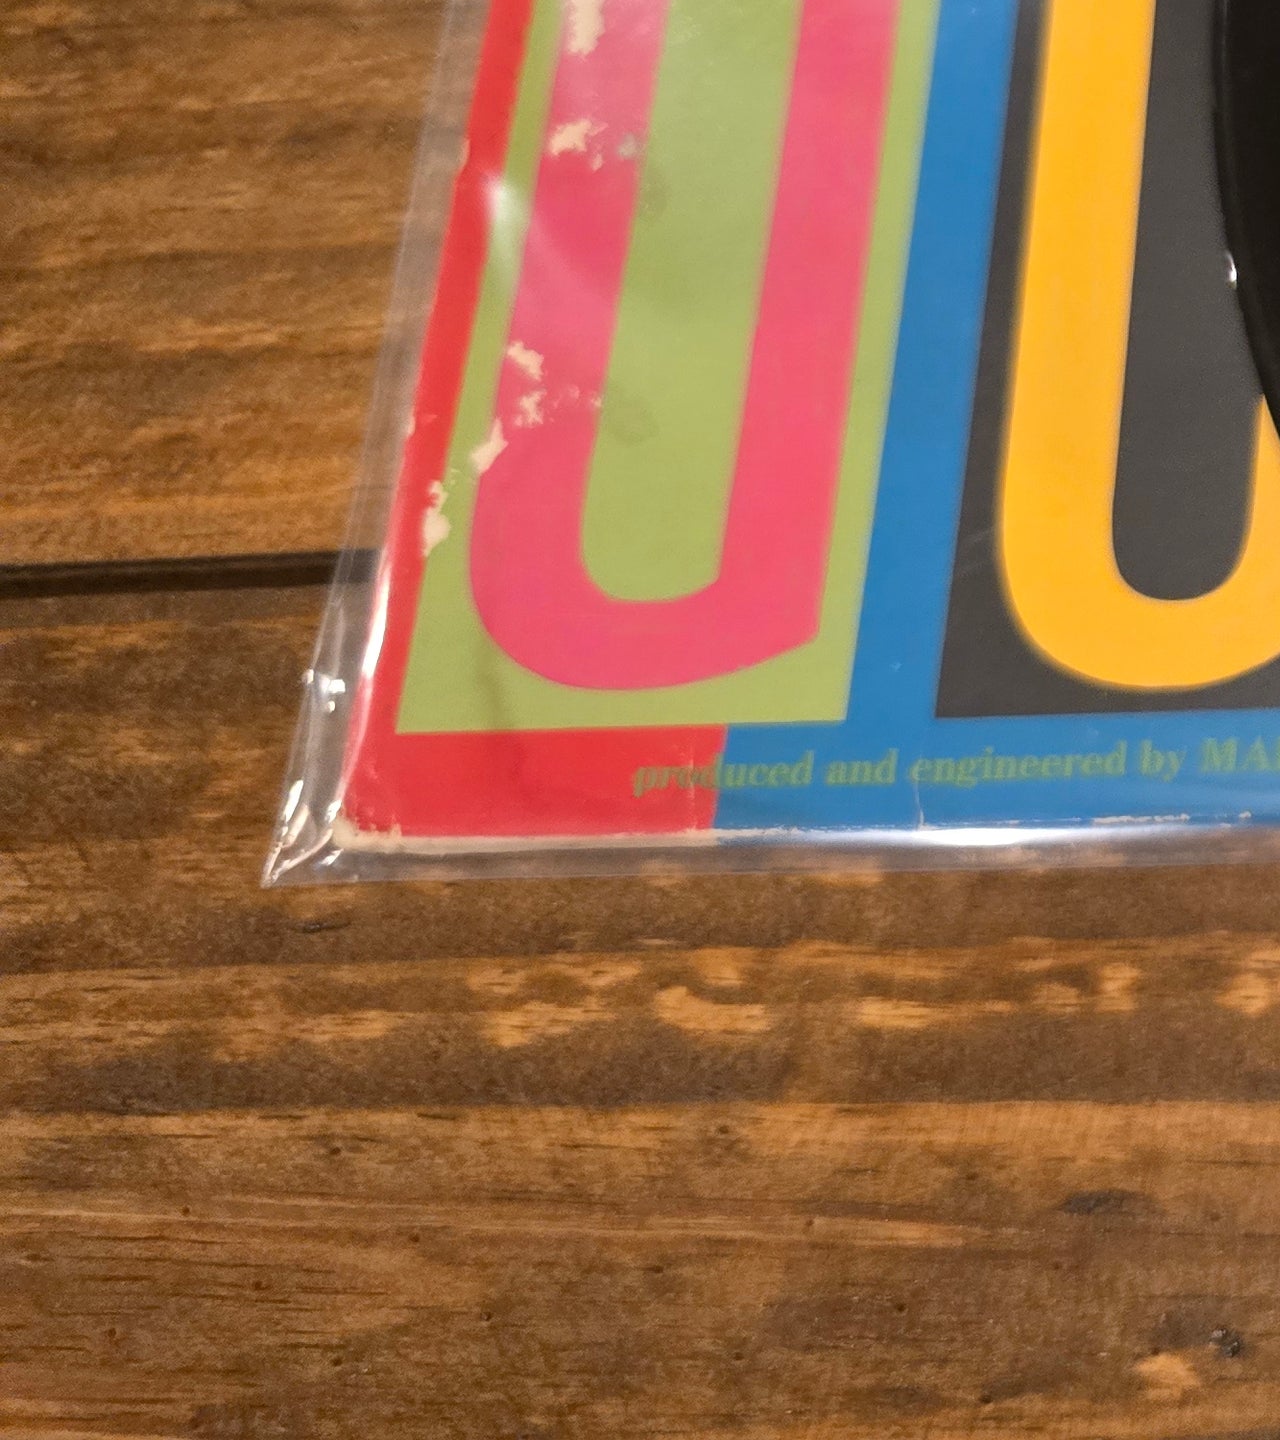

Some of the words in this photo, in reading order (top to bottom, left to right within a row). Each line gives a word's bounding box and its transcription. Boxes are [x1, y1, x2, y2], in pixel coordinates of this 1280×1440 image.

[632, 746, 815, 796] produced
[826, 746, 897, 786] and
[909, 735, 1129, 789] engineered
[1140, 736, 1184, 782] by
